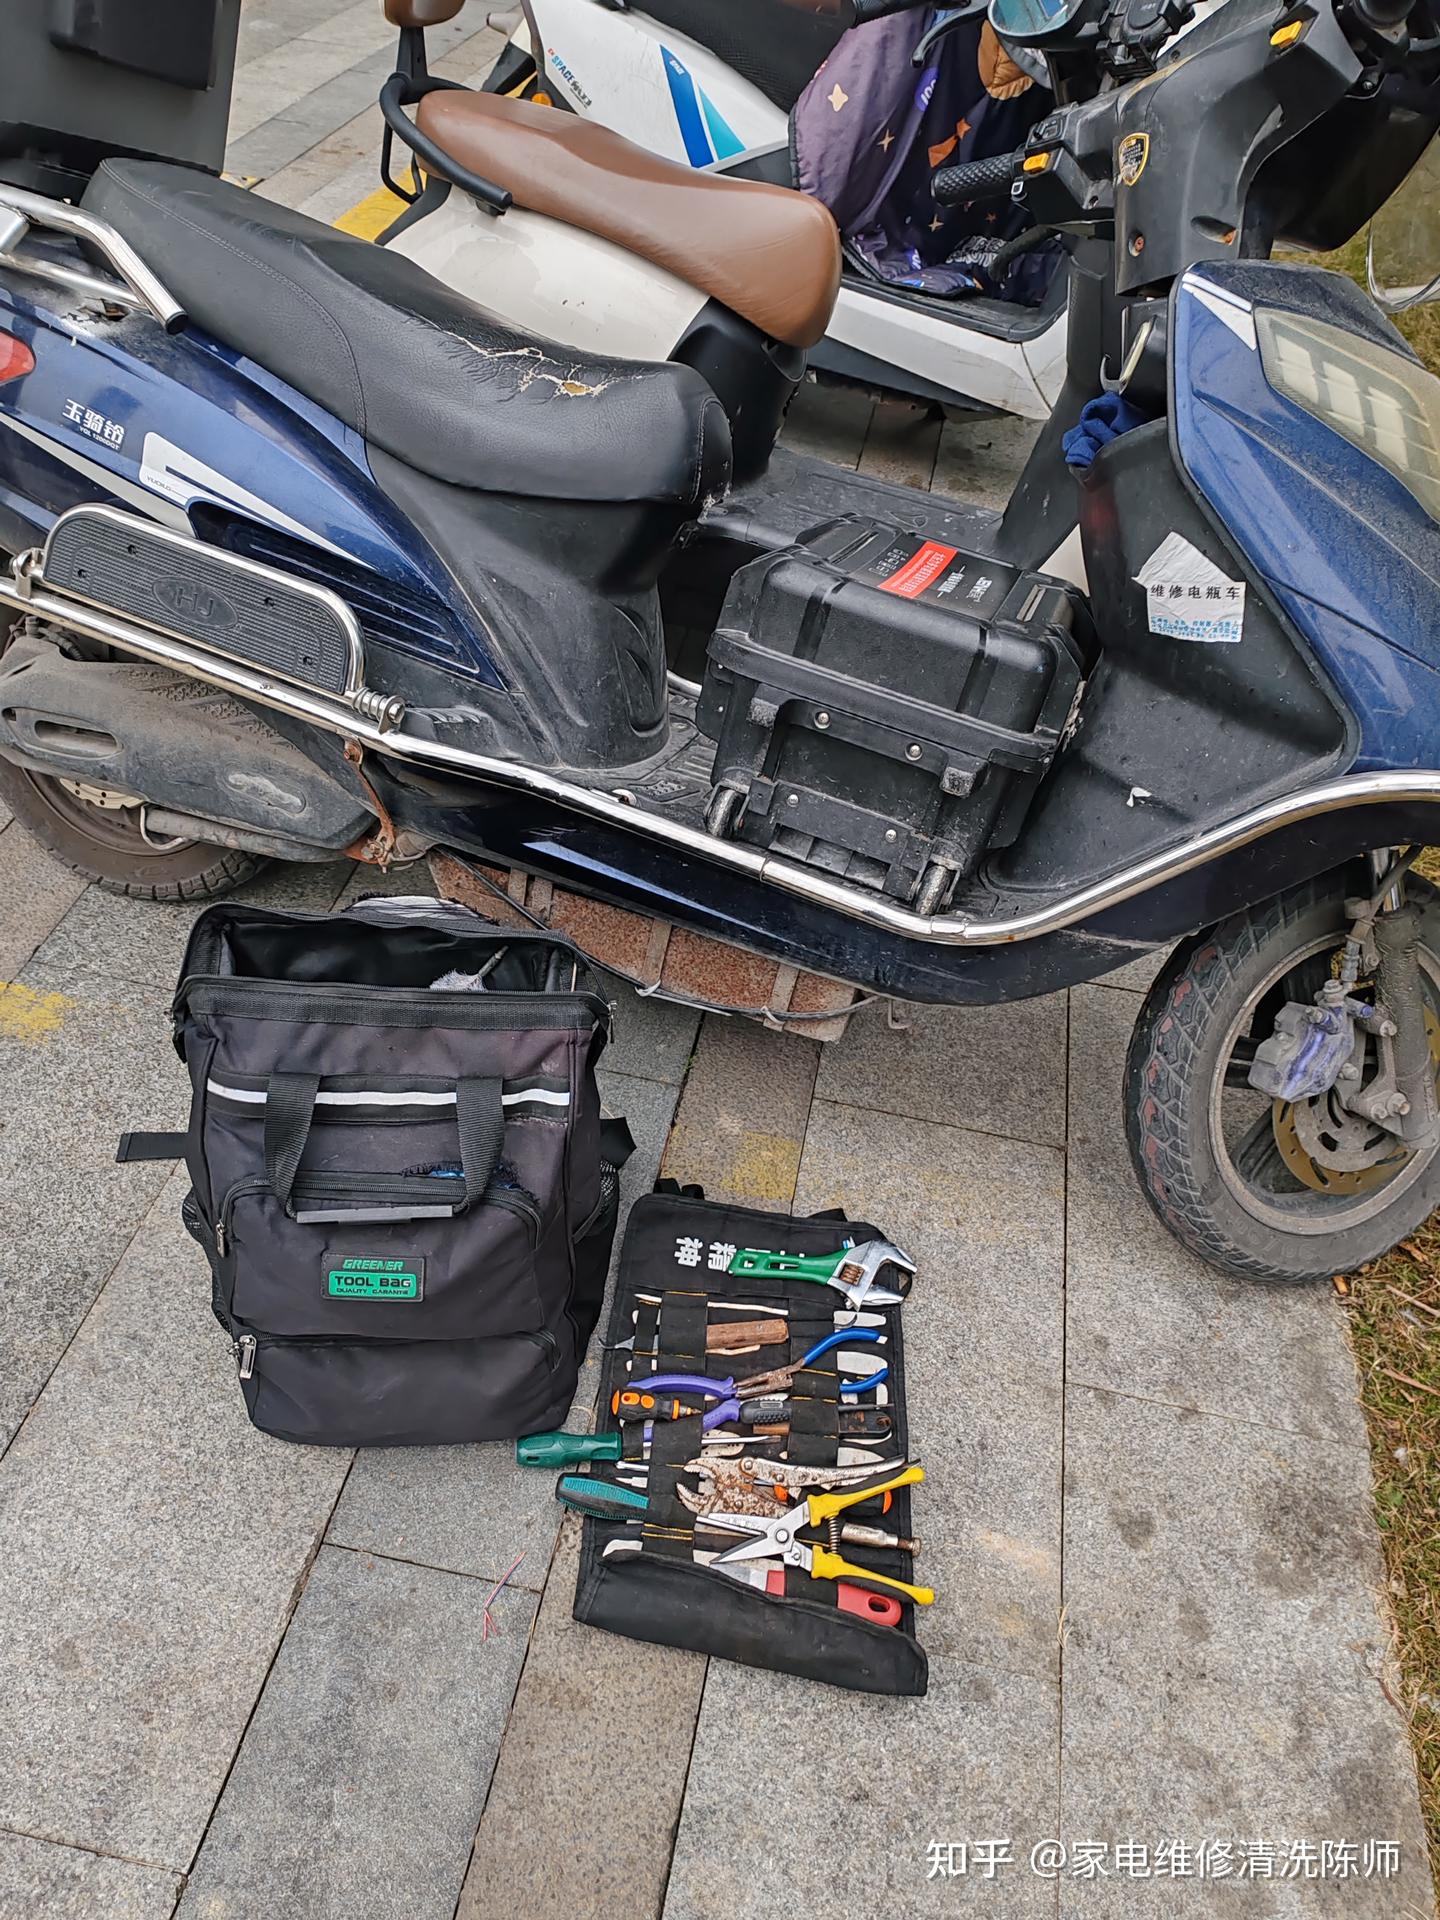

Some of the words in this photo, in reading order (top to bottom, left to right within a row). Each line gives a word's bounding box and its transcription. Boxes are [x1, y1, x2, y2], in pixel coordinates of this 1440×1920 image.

[551, 55, 575, 83] SPACE
[62, 398, 125, 444] 玉骑铃
[176, 587, 215, 617] HJ
[1150, 584, 1240, 600] 维修电瓶车
[342, 1259, 404, 1271] GREENER
[335, 1276, 374, 1287] TOOL
